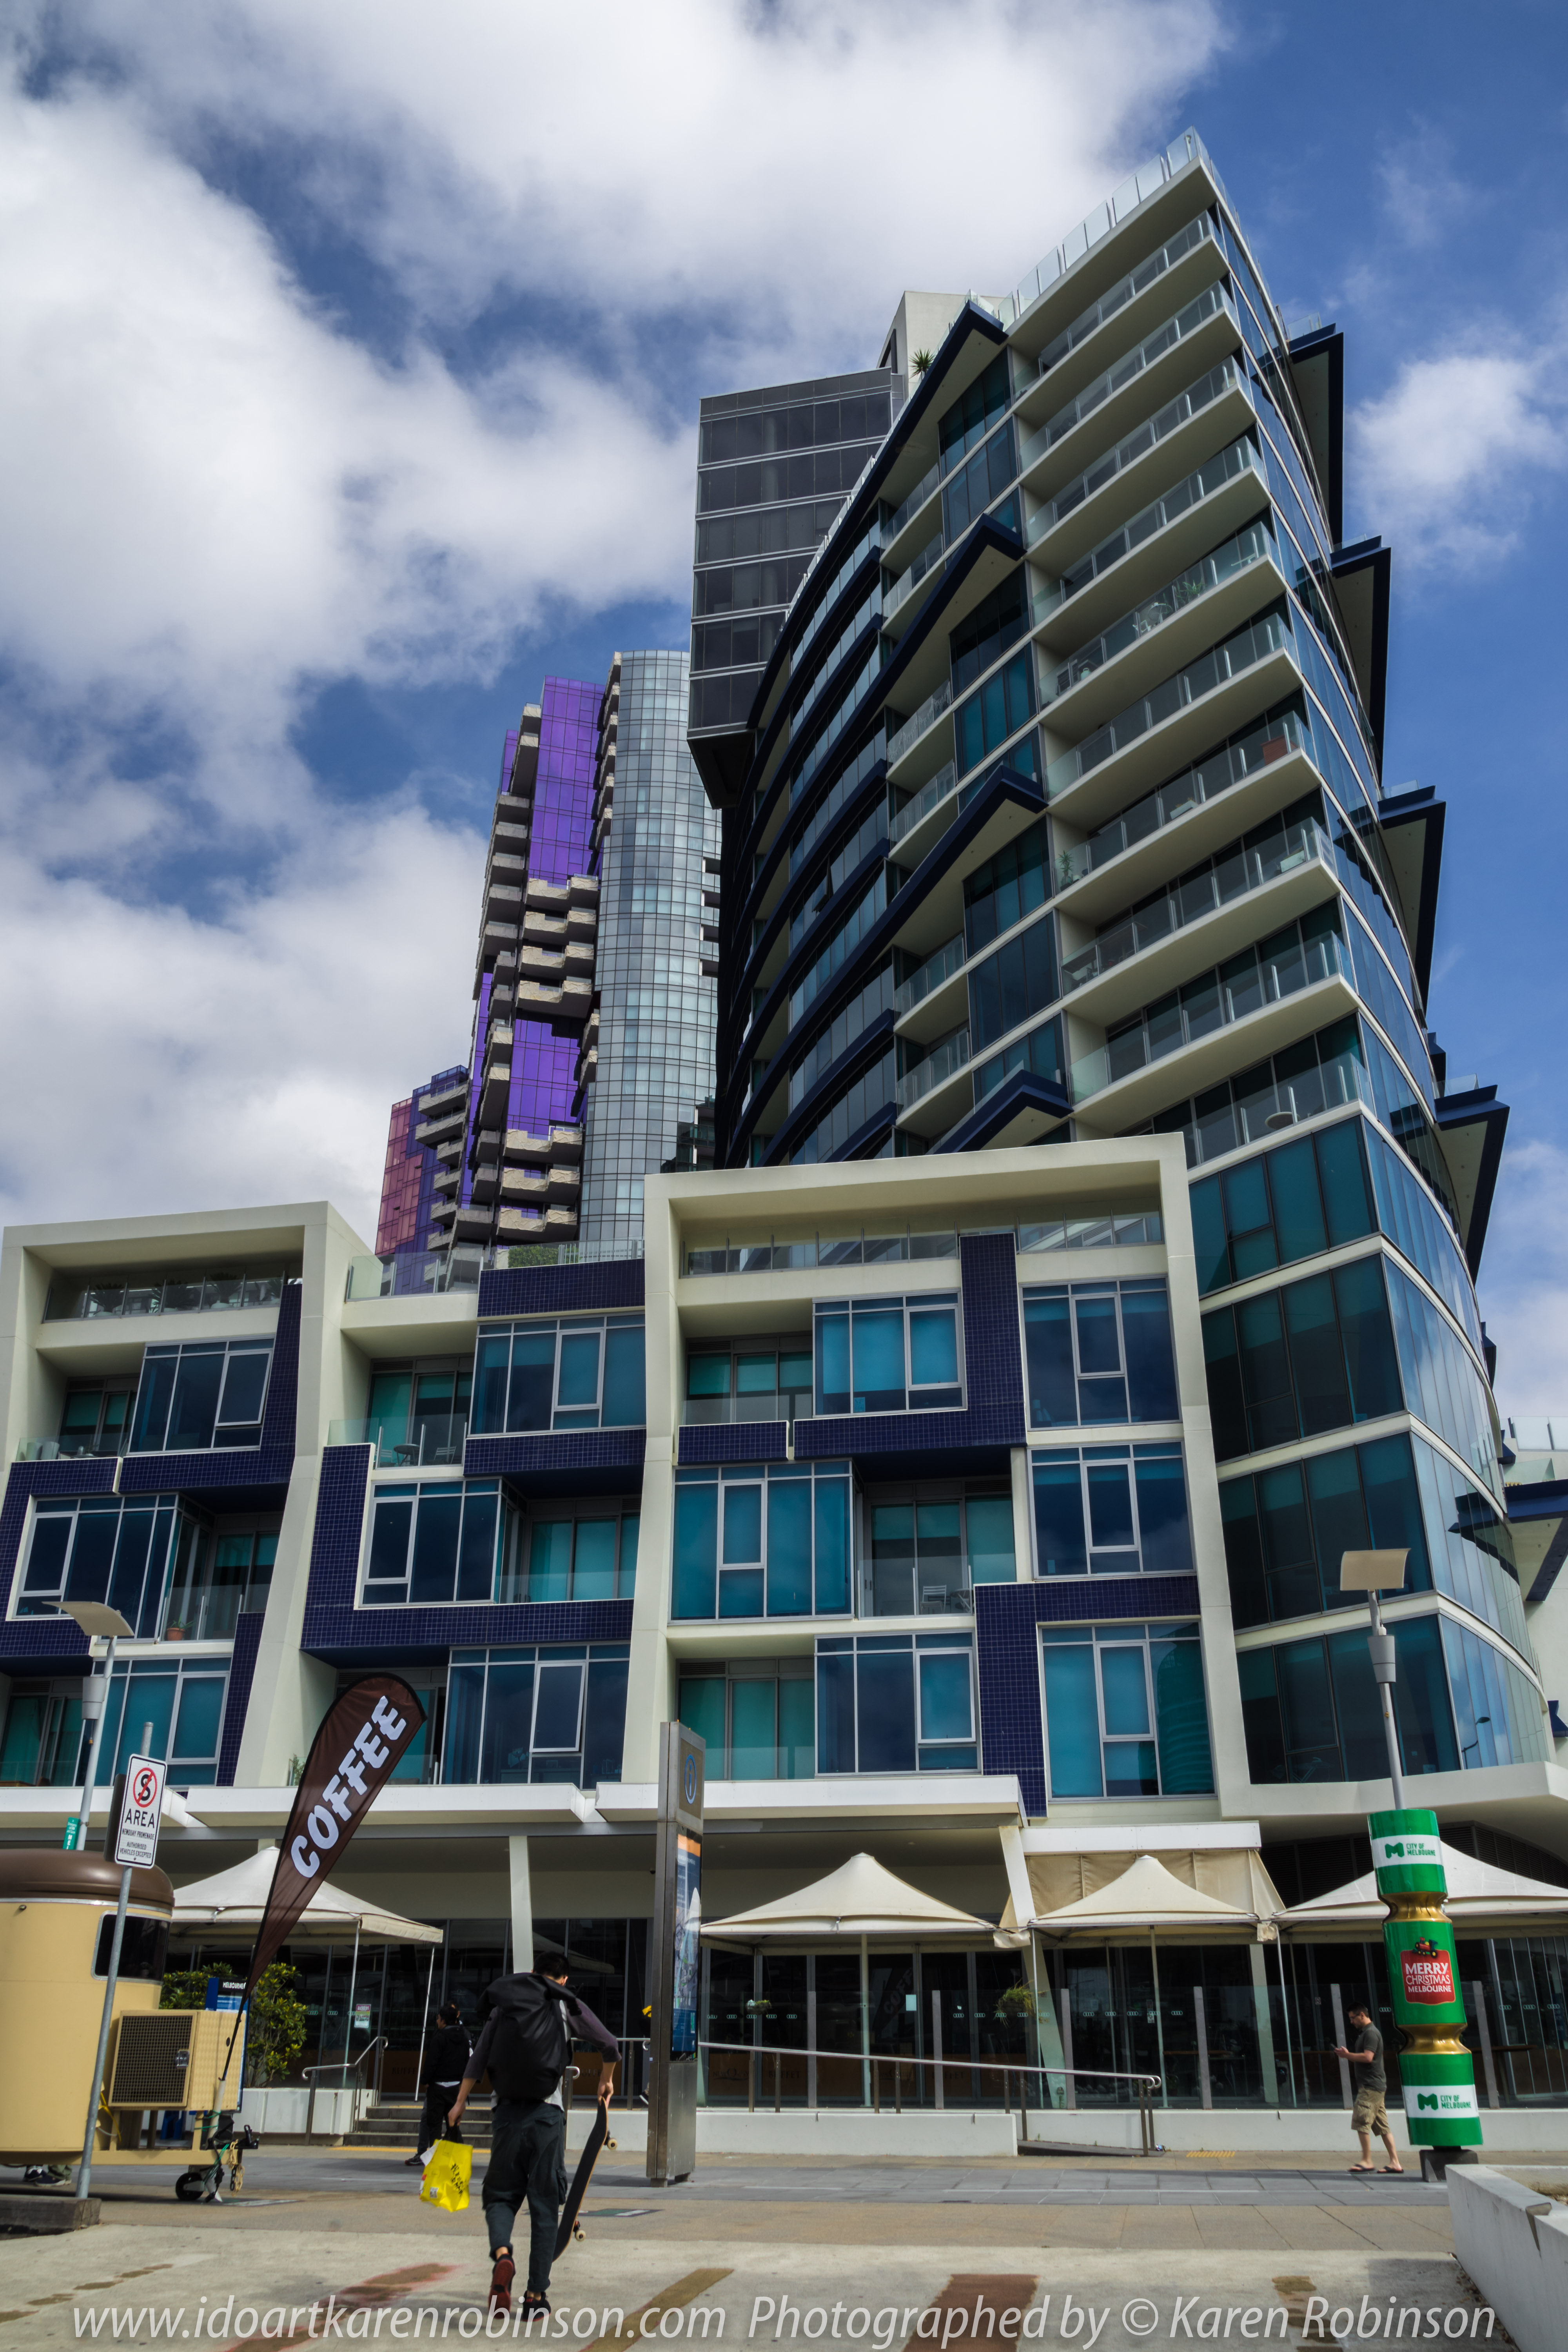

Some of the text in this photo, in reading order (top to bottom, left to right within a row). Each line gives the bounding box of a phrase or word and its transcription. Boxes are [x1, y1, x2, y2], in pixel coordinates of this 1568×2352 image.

[291, 1695, 407, 1878] COFFEE
[125, 1808, 155, 1829] AREA
[122, 1828, 154, 1840] NEWQUAY PROMENADE
[127, 1841, 147, 1850] AUTHORISED
[136, 1850, 152, 1858] EXCEPTED
[1405, 1962, 1448, 1975] MERRY
[1406, 1975, 1451, 1985] CHRISTMAS
[768, 2070, 801, 2079] BFFET
